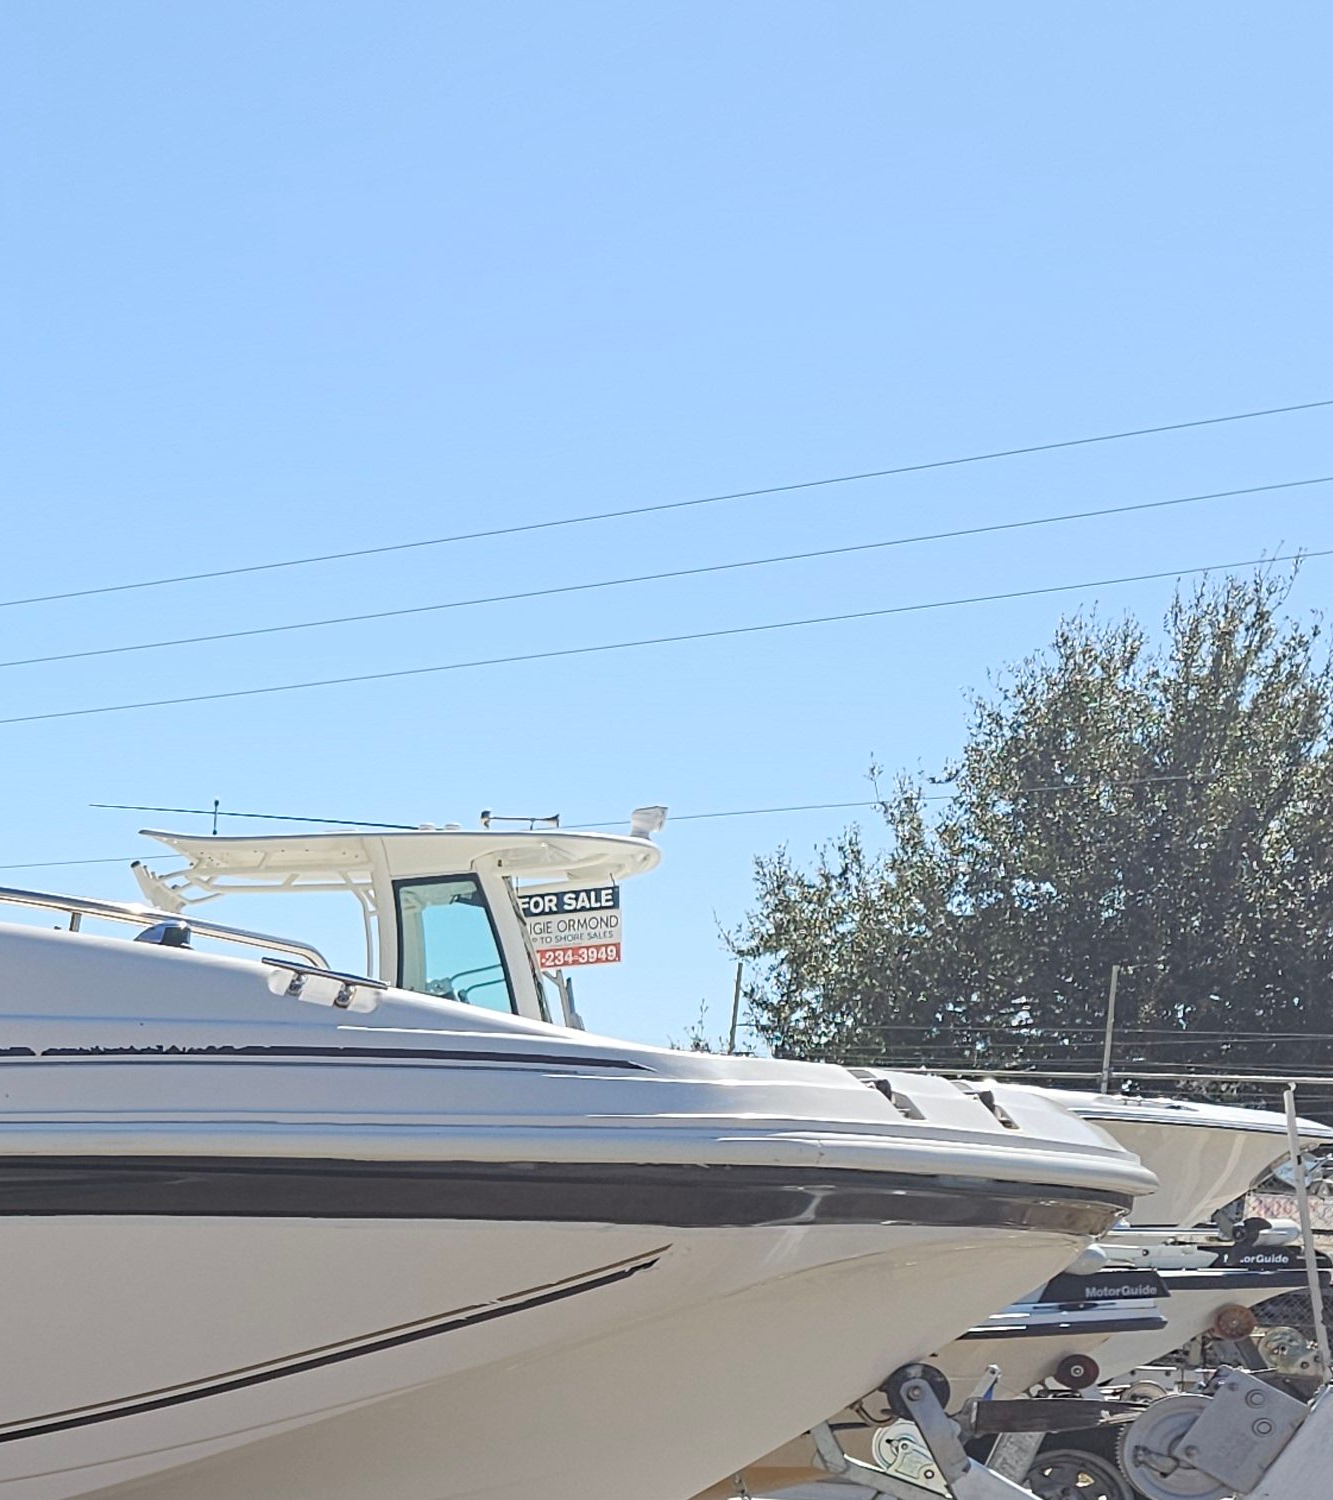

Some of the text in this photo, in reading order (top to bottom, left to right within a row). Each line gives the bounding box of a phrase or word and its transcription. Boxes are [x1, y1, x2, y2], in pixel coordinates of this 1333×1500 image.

[519, 889, 613, 914] FOR SALE
[557, 915, 619, 933] ORMOND
[539, 936, 552, 944] TO
[555, 933, 584, 943] SHORE
[587, 930, 613, 940] SALES
[1223, 1253, 1289, 1264] orGuide
[1085, 1284, 1157, 1298] MotorGuide
